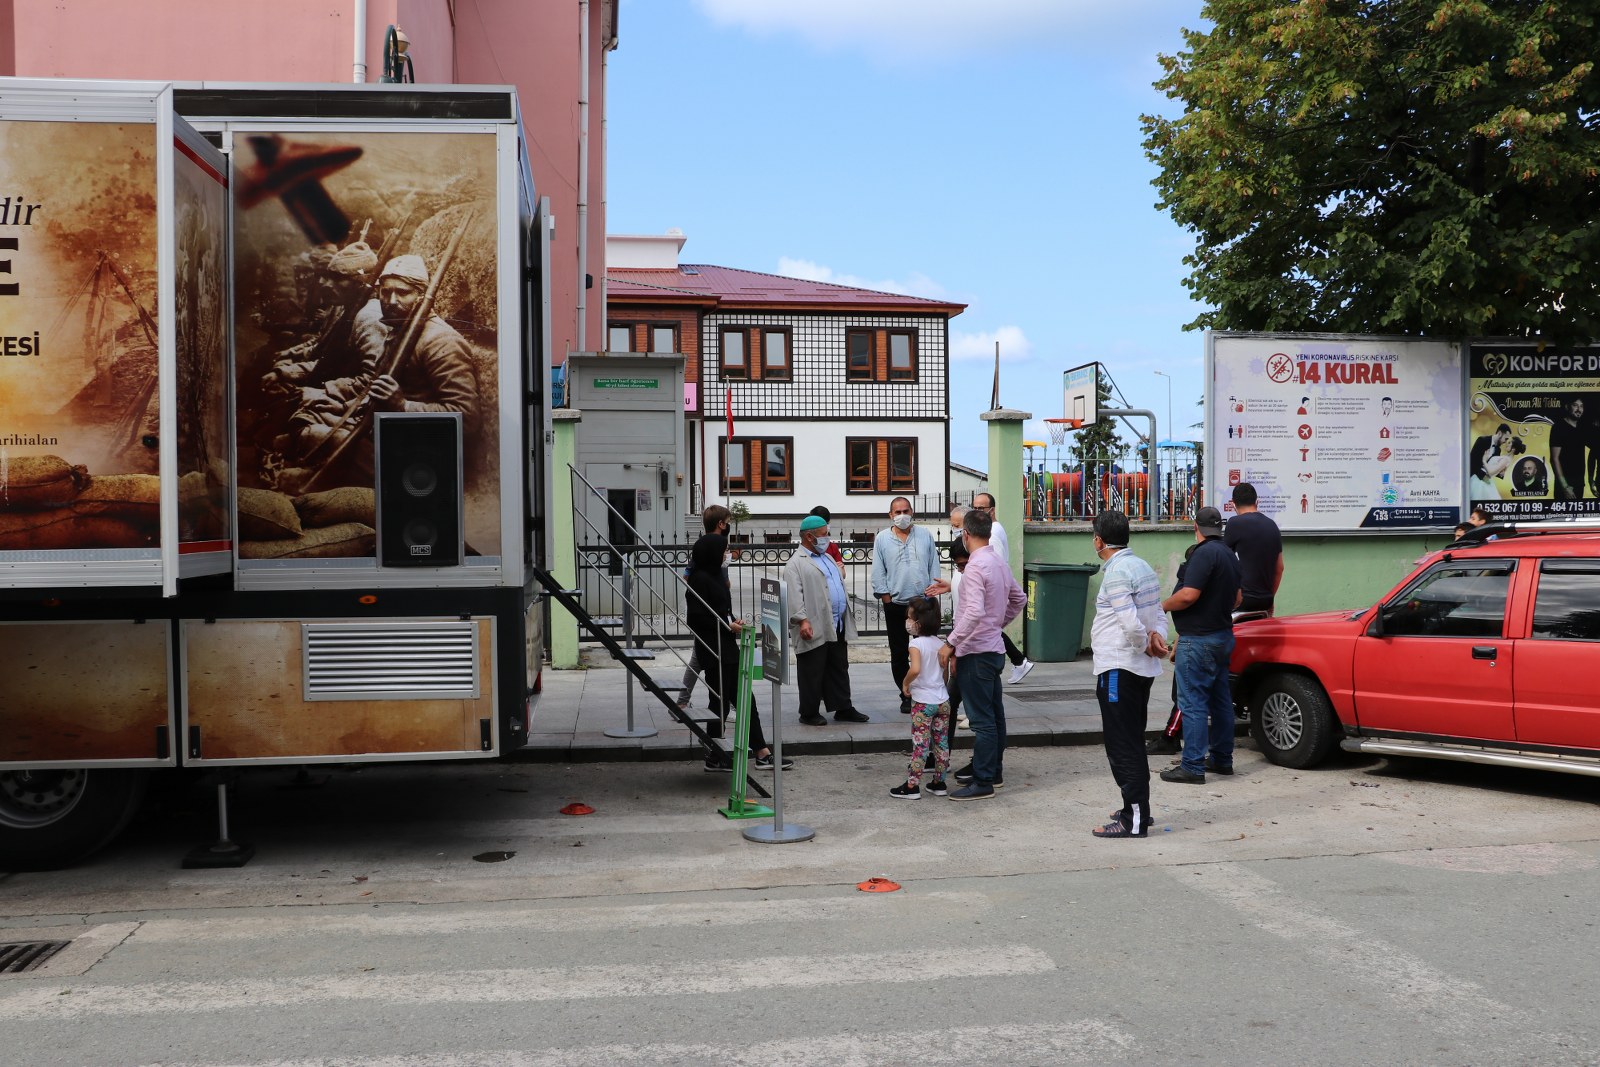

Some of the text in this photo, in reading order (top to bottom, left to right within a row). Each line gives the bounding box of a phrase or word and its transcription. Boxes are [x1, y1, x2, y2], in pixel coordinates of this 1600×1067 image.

[1510, 355, 1600, 371] KONFOR D
[1325, 362, 1399, 384] KURAL
[1506, 397, 1531, 408] Dursun
[1484, 503, 1500, 513] 532
[1501, 502, 1518, 513] 067
[1519, 502, 1530, 512] 10
[1531, 502, 1543, 512] 99
[1550, 501, 1567, 512] 464
[1568, 501, 1584, 511] 715
[1585, 501, 1595, 511] 11
